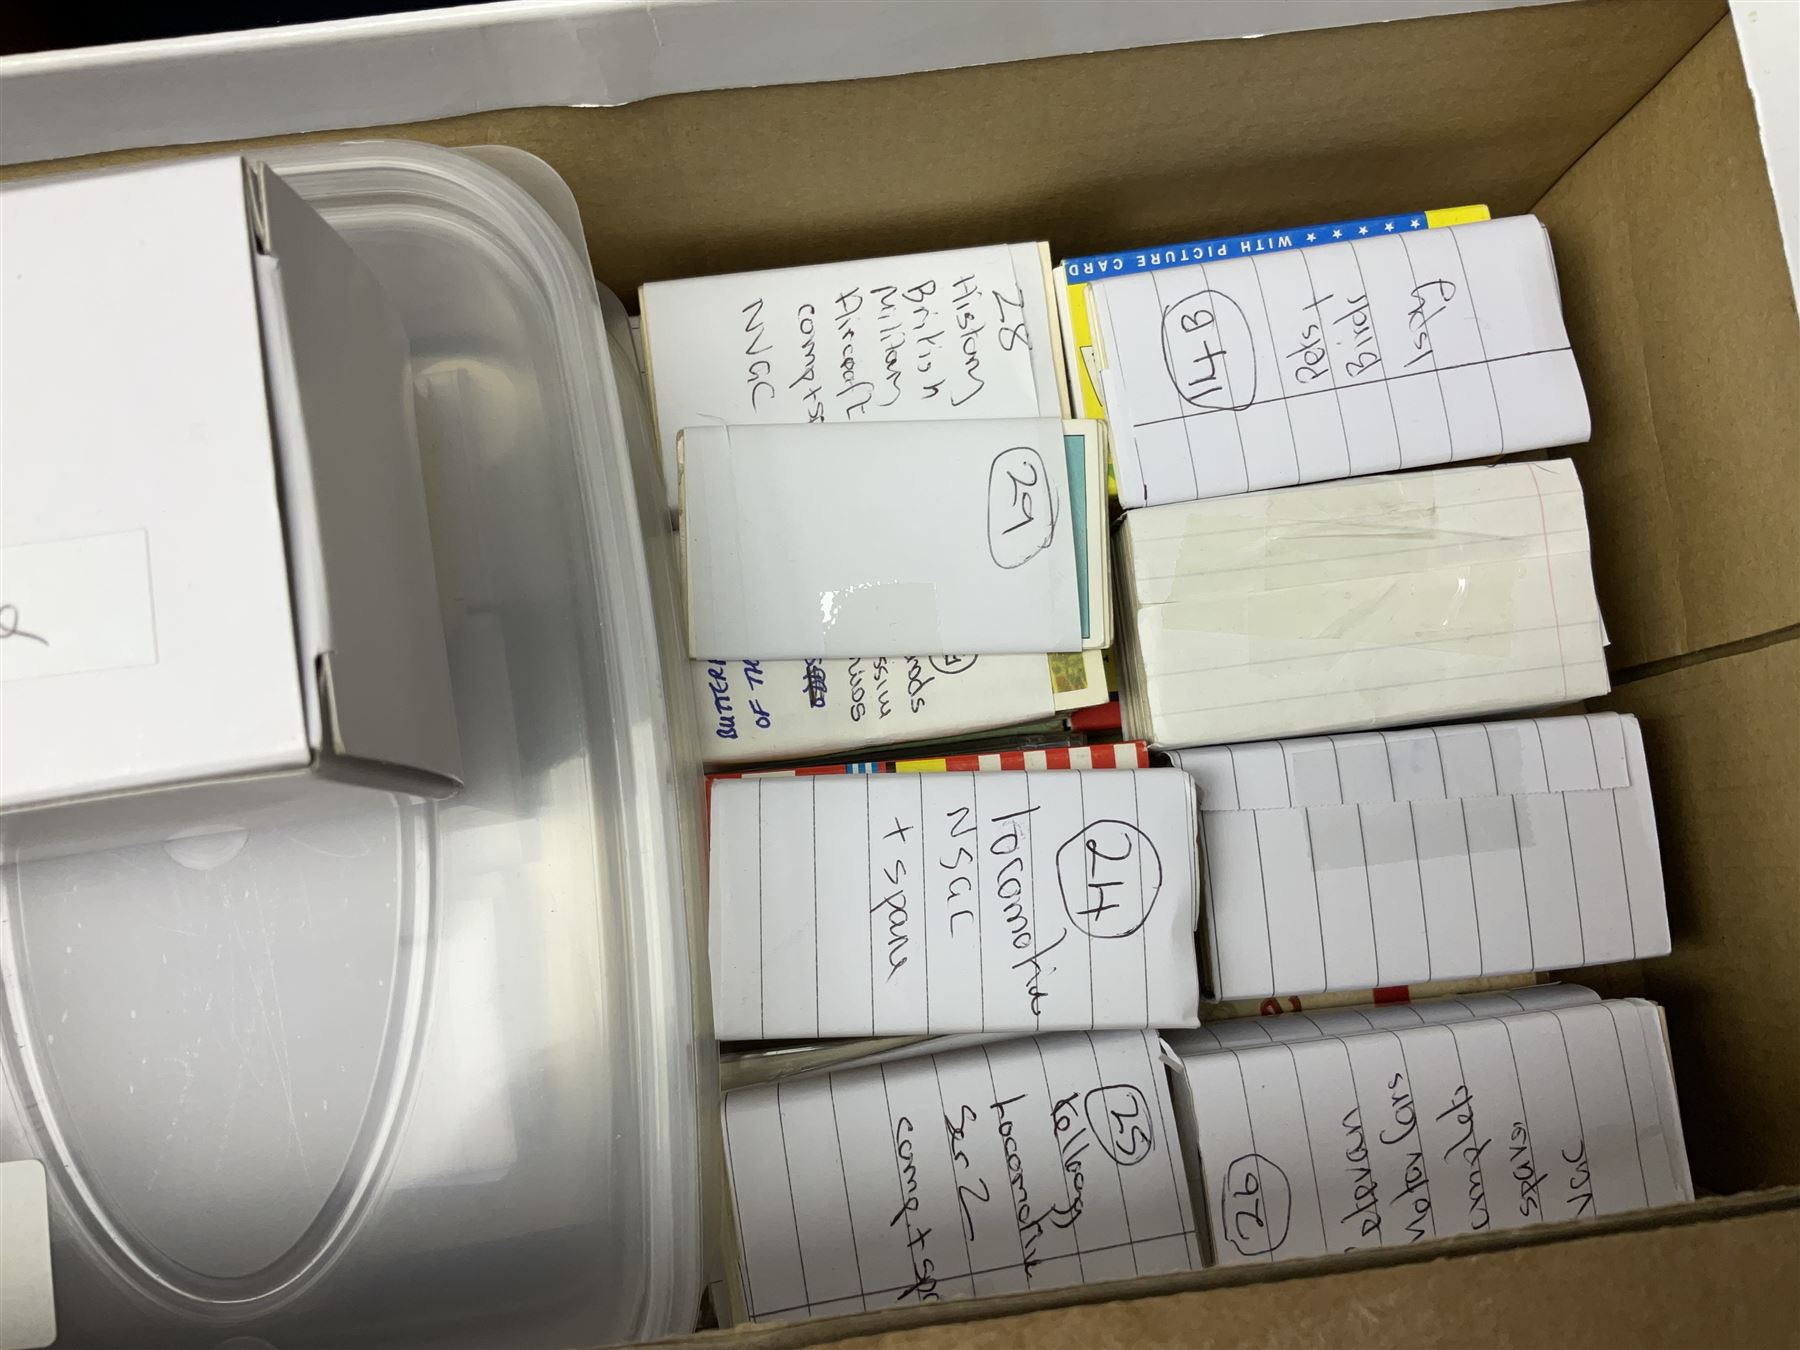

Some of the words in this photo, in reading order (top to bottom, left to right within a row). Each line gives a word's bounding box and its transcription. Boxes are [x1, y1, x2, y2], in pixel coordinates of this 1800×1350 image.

[1069, 255, 1123, 277] CARD
[1136, 243, 1227, 268] PICTURE
[1240, 234, 1293, 253] WITH
[870, 285, 901, 407] Military
[901, 280, 945, 400] British
[951, 274, 985, 407] History
[991, 285, 1033, 351] 28
[1286, 322, 1331, 384] Pets
[1001, 460, 1038, 535] 29
[755, 699, 772, 730] OF
[1075, 832, 1133, 921] 24
[1110, 1091, 1152, 1156] 25
[957, 1177, 991, 1242] 2
[1233, 1171, 1264, 1240] 26
